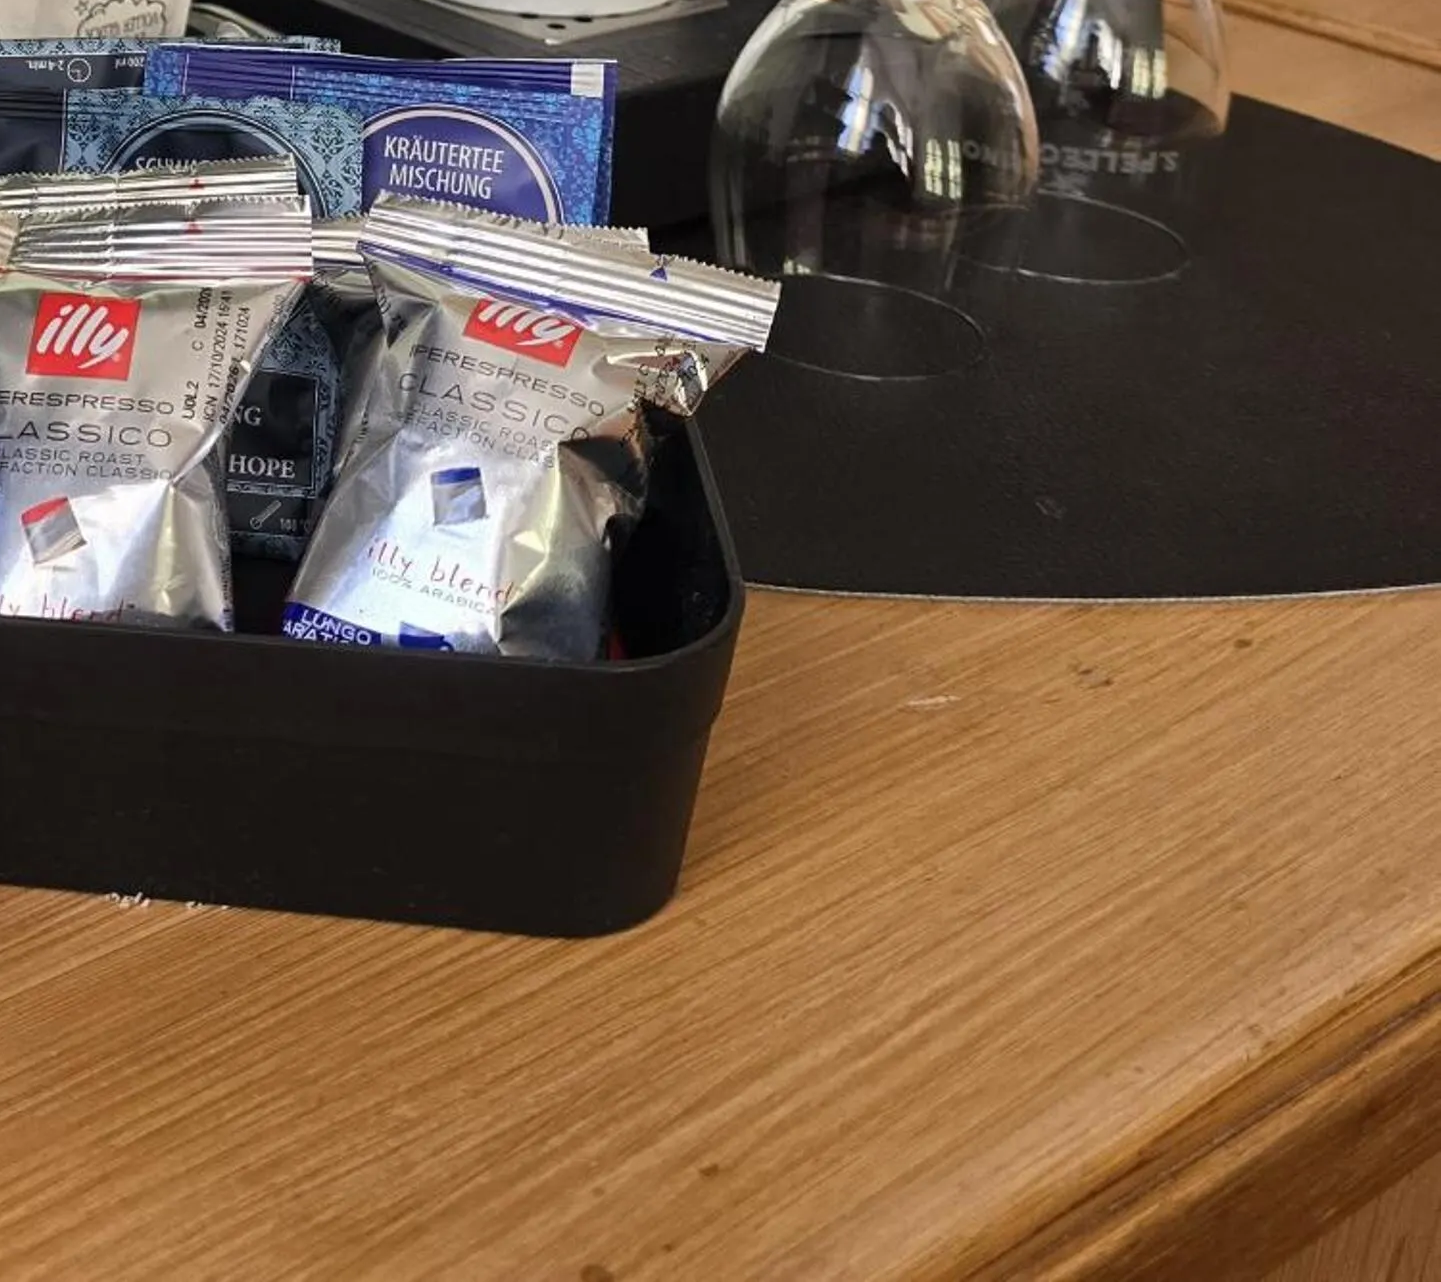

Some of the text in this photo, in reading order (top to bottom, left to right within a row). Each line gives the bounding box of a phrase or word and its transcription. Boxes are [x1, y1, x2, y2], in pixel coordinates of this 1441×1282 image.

[383, 134, 505, 175] KRÄUTERTEE
[389, 162, 492, 200] MISCHUNG
[36, 303, 129, 369] illy
[409, 344, 606, 418] IPERESPRESSO
[399, 372, 592, 442] CLASSICO
[78, 451, 146, 466] ROAST
[229, 453, 295, 479] HOPE
[367, 537, 412, 577] illy
[301, 608, 373, 646] LUNGO
